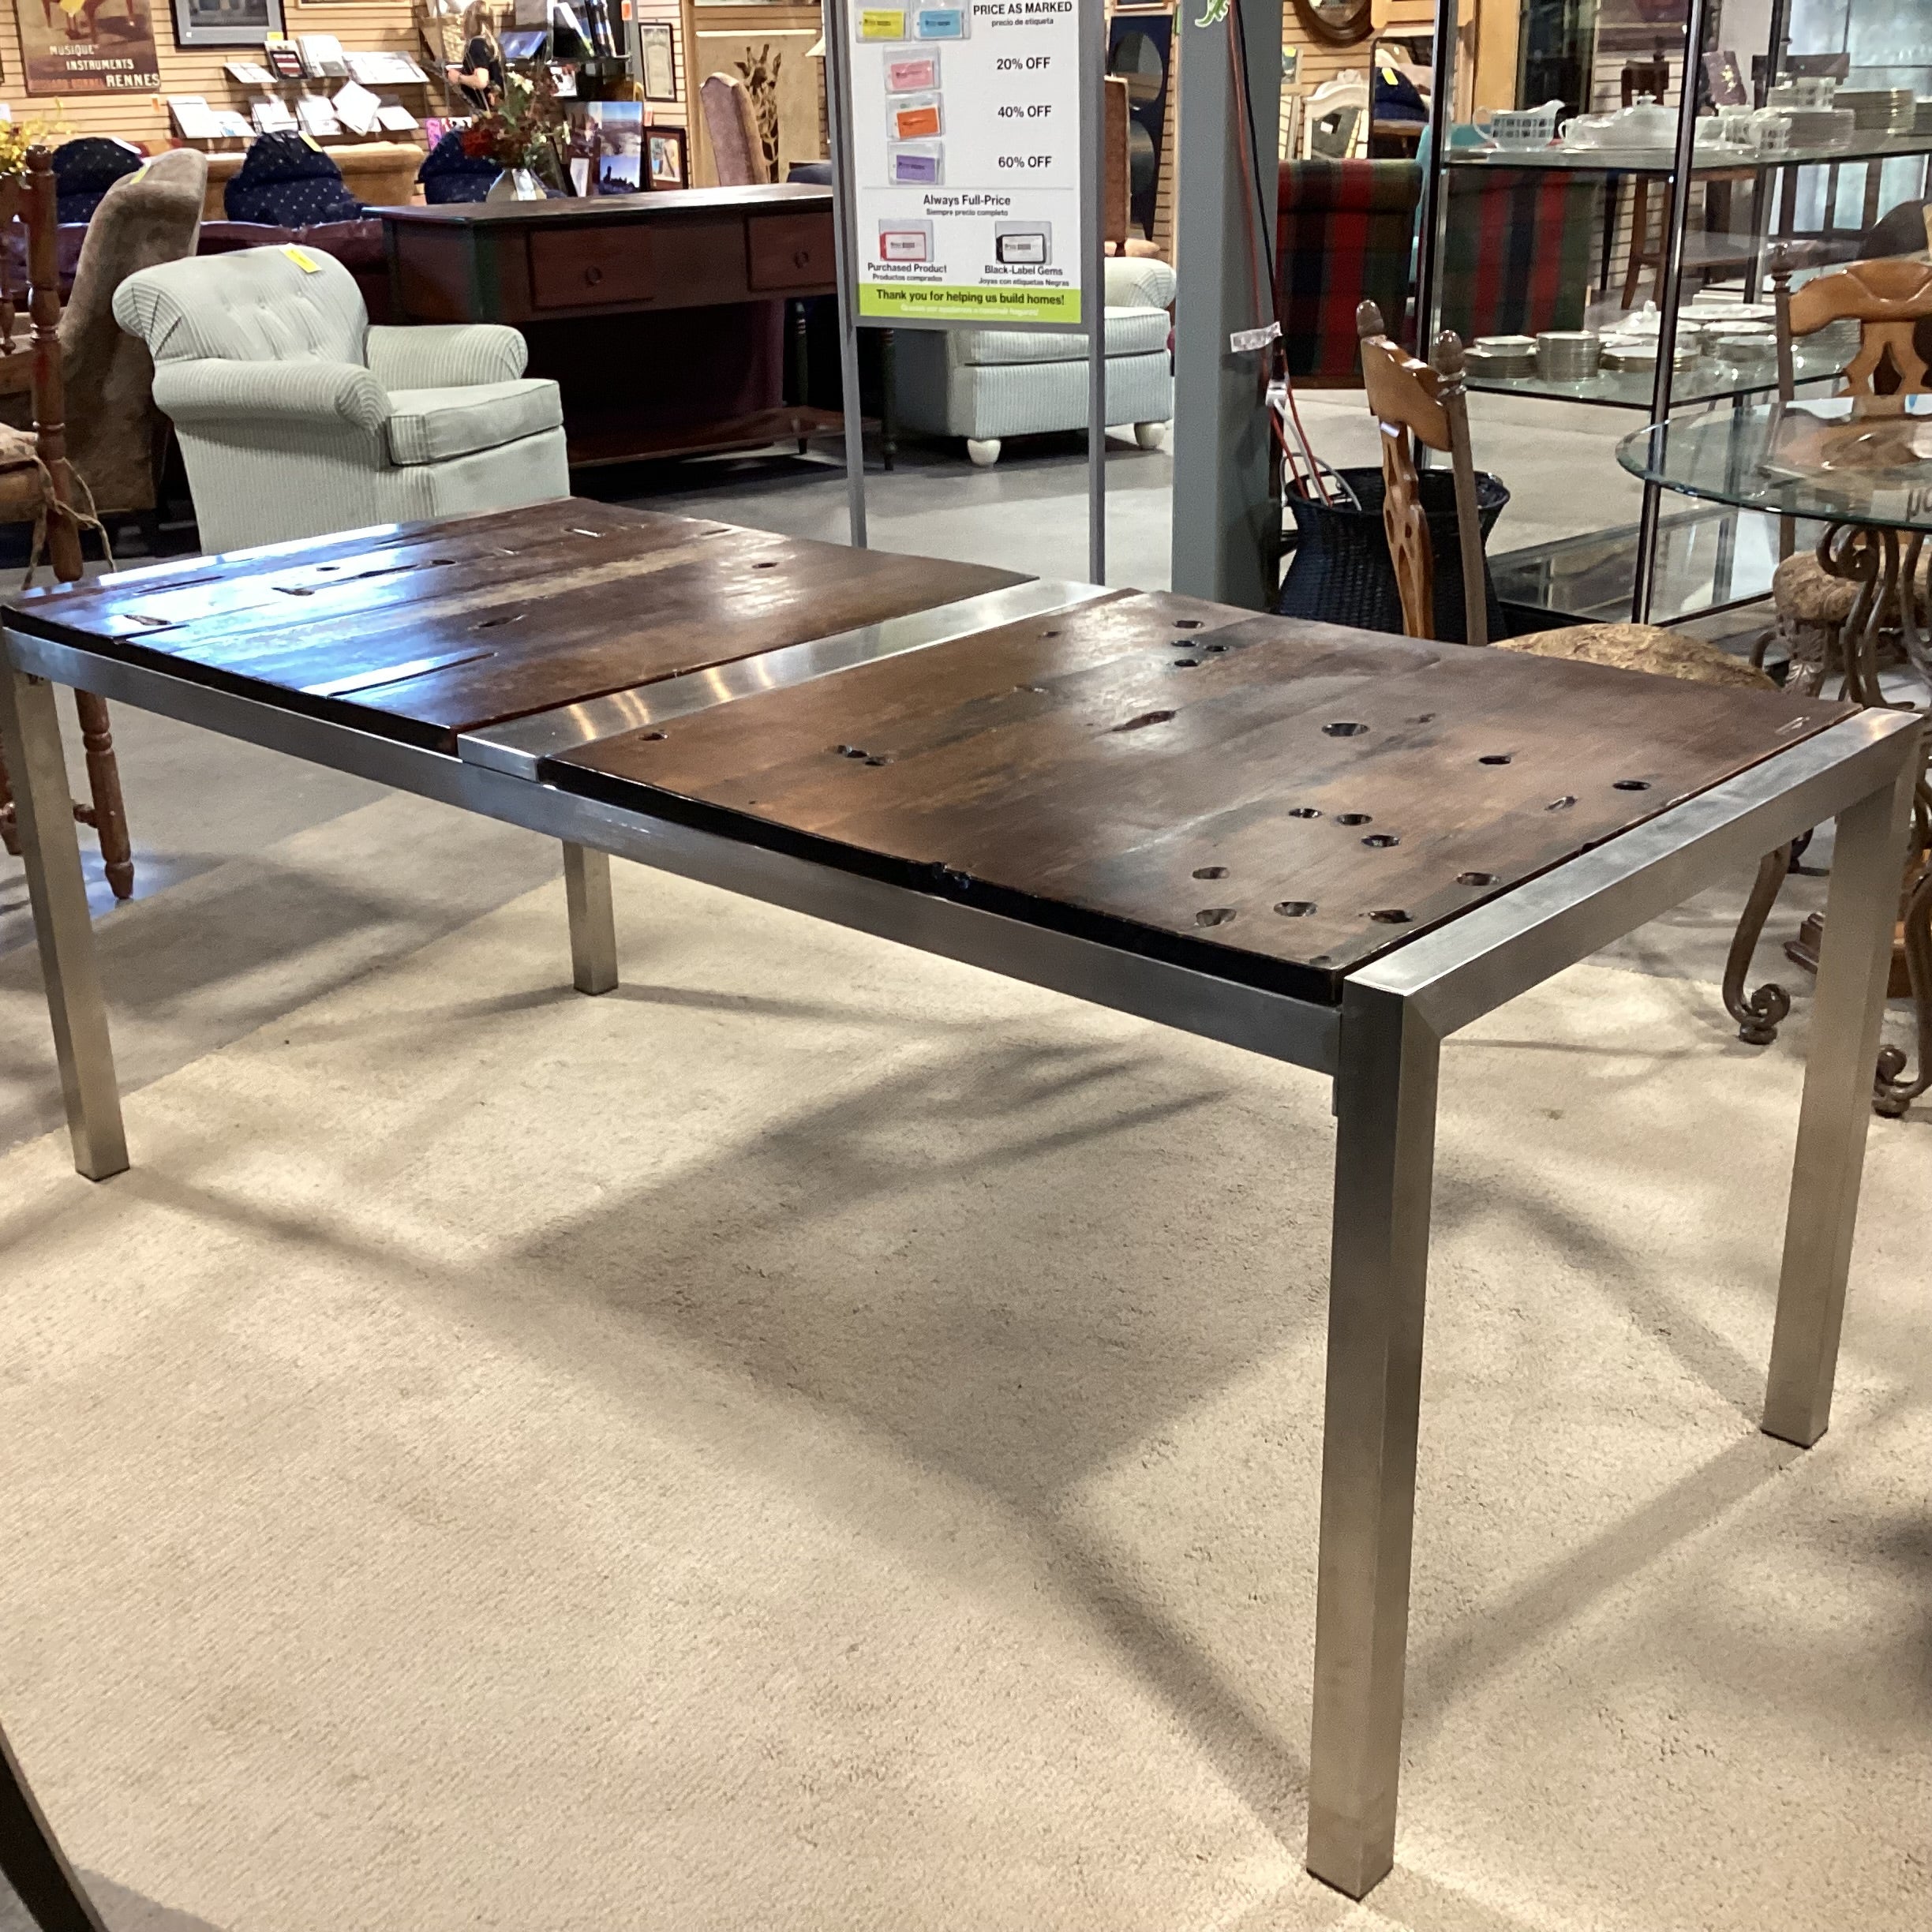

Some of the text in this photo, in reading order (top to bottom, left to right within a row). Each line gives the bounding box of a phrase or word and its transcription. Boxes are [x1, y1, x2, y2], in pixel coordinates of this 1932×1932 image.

[973, 2, 1073, 15] PRICE AS MARKED
[49, 44, 94, 56] MUSIQUE
[66, 58, 134, 70] INSTRUMENTS
[997, 57, 1050, 69] 20% OFF
[106, 73, 160, 87] RENNES
[998, 105, 1051, 118] 40% OFF
[998, 155, 1052, 168] 60% OFF
[923, 194, 1011, 207] Always Full-Price
[867, 263, 947, 273] Purchased Product
[984, 265, 1063, 275] Black-Label Gems
[876, 289, 1065, 305] Thank you for helping us build homes!
